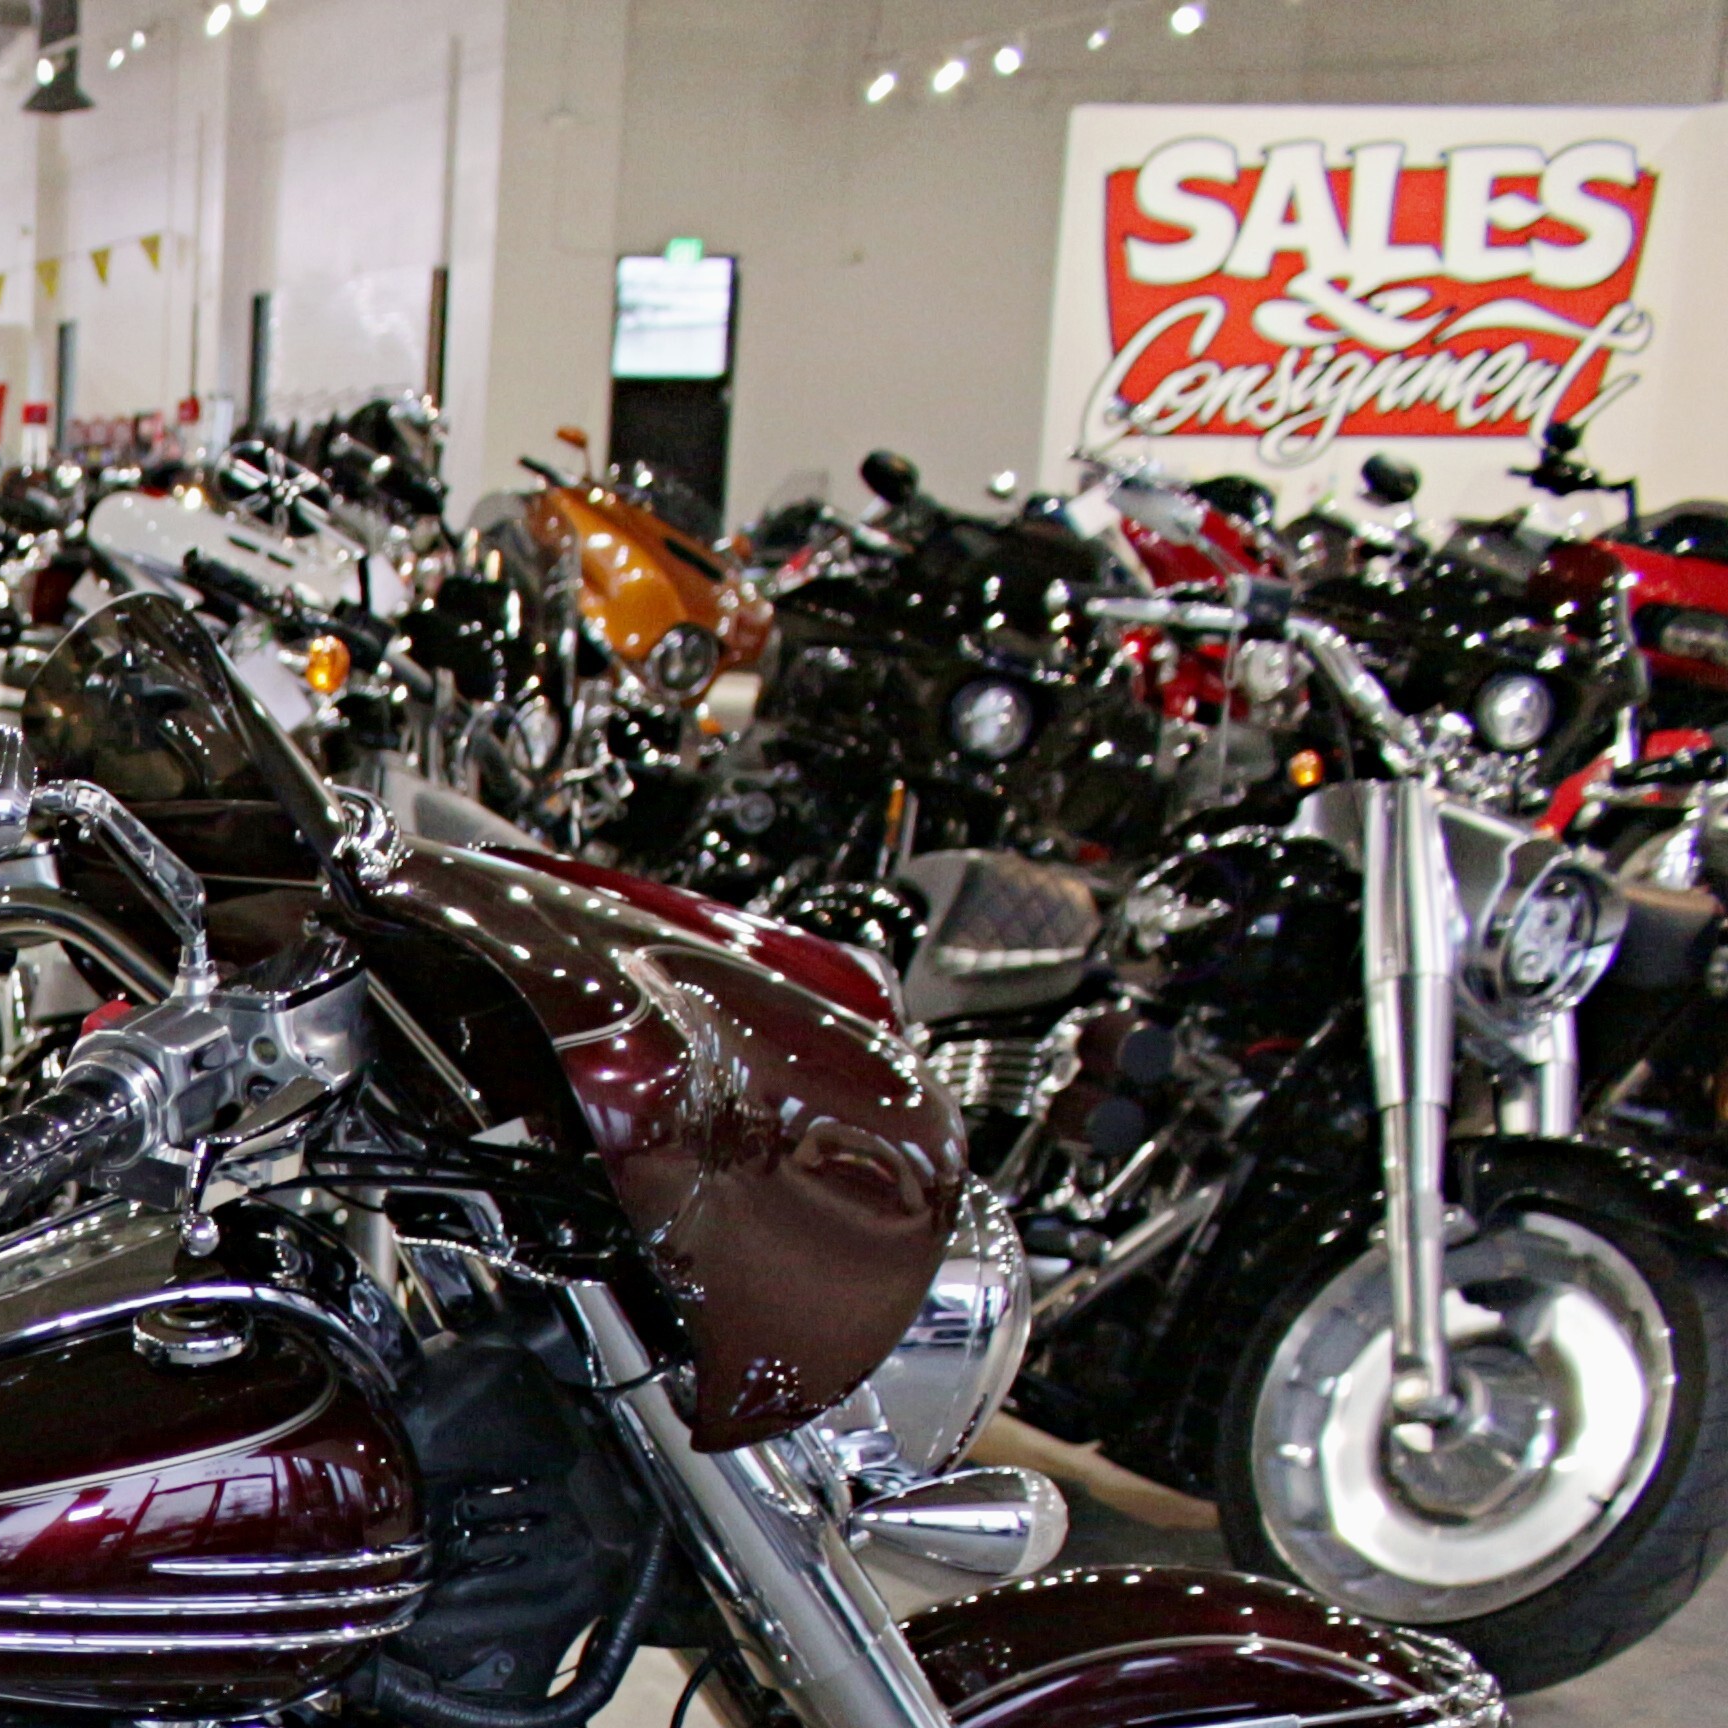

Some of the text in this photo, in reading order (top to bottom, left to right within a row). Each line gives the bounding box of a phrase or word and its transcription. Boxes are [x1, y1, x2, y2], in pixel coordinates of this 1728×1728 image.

[1122, 135, 1640, 289] SALES
[1079, 296, 1653, 466] Consignment
[1250, 268, 1455, 350] &
